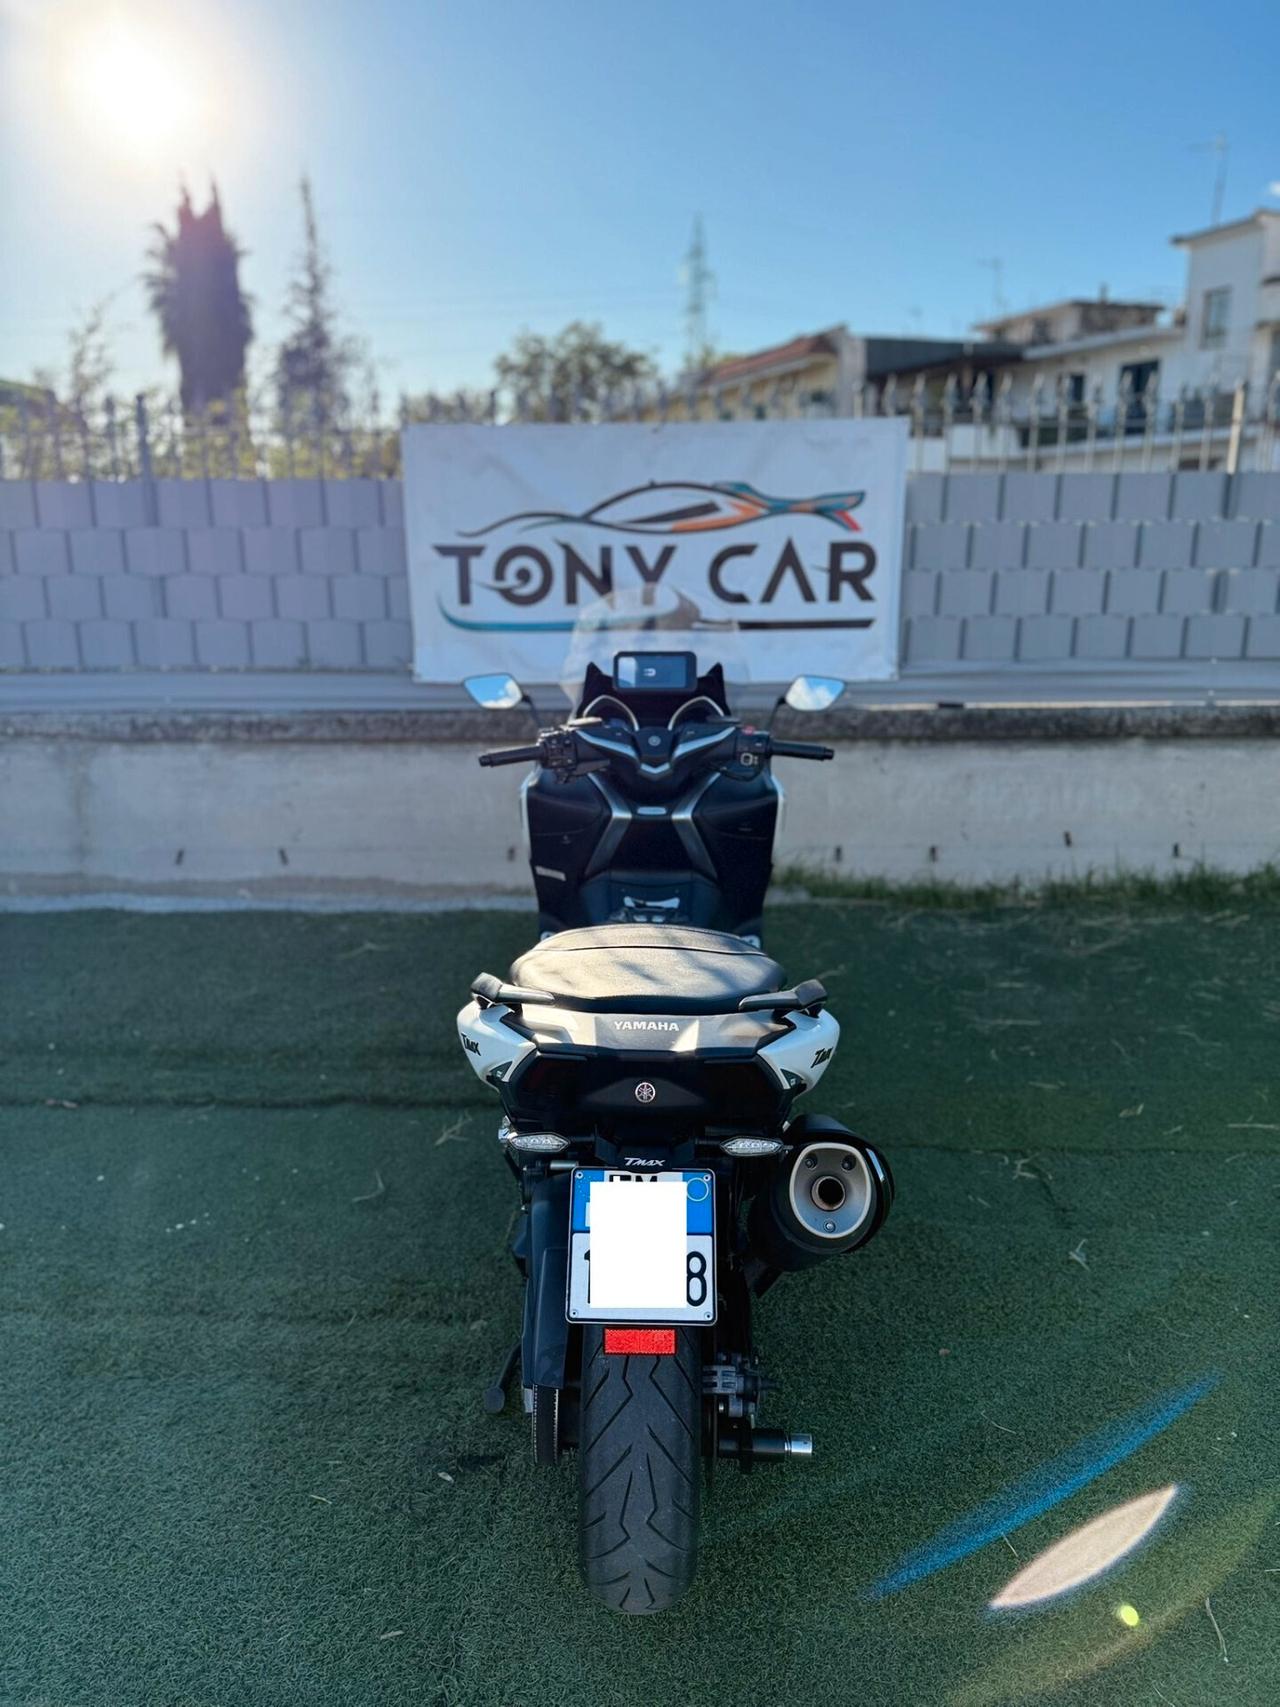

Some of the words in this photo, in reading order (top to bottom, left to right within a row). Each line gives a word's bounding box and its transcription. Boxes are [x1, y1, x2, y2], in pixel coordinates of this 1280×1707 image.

[432, 539, 677, 607] TONY
[707, 537, 877, 604] CAR
[614, 1021, 680, 1032] YAMAHA
